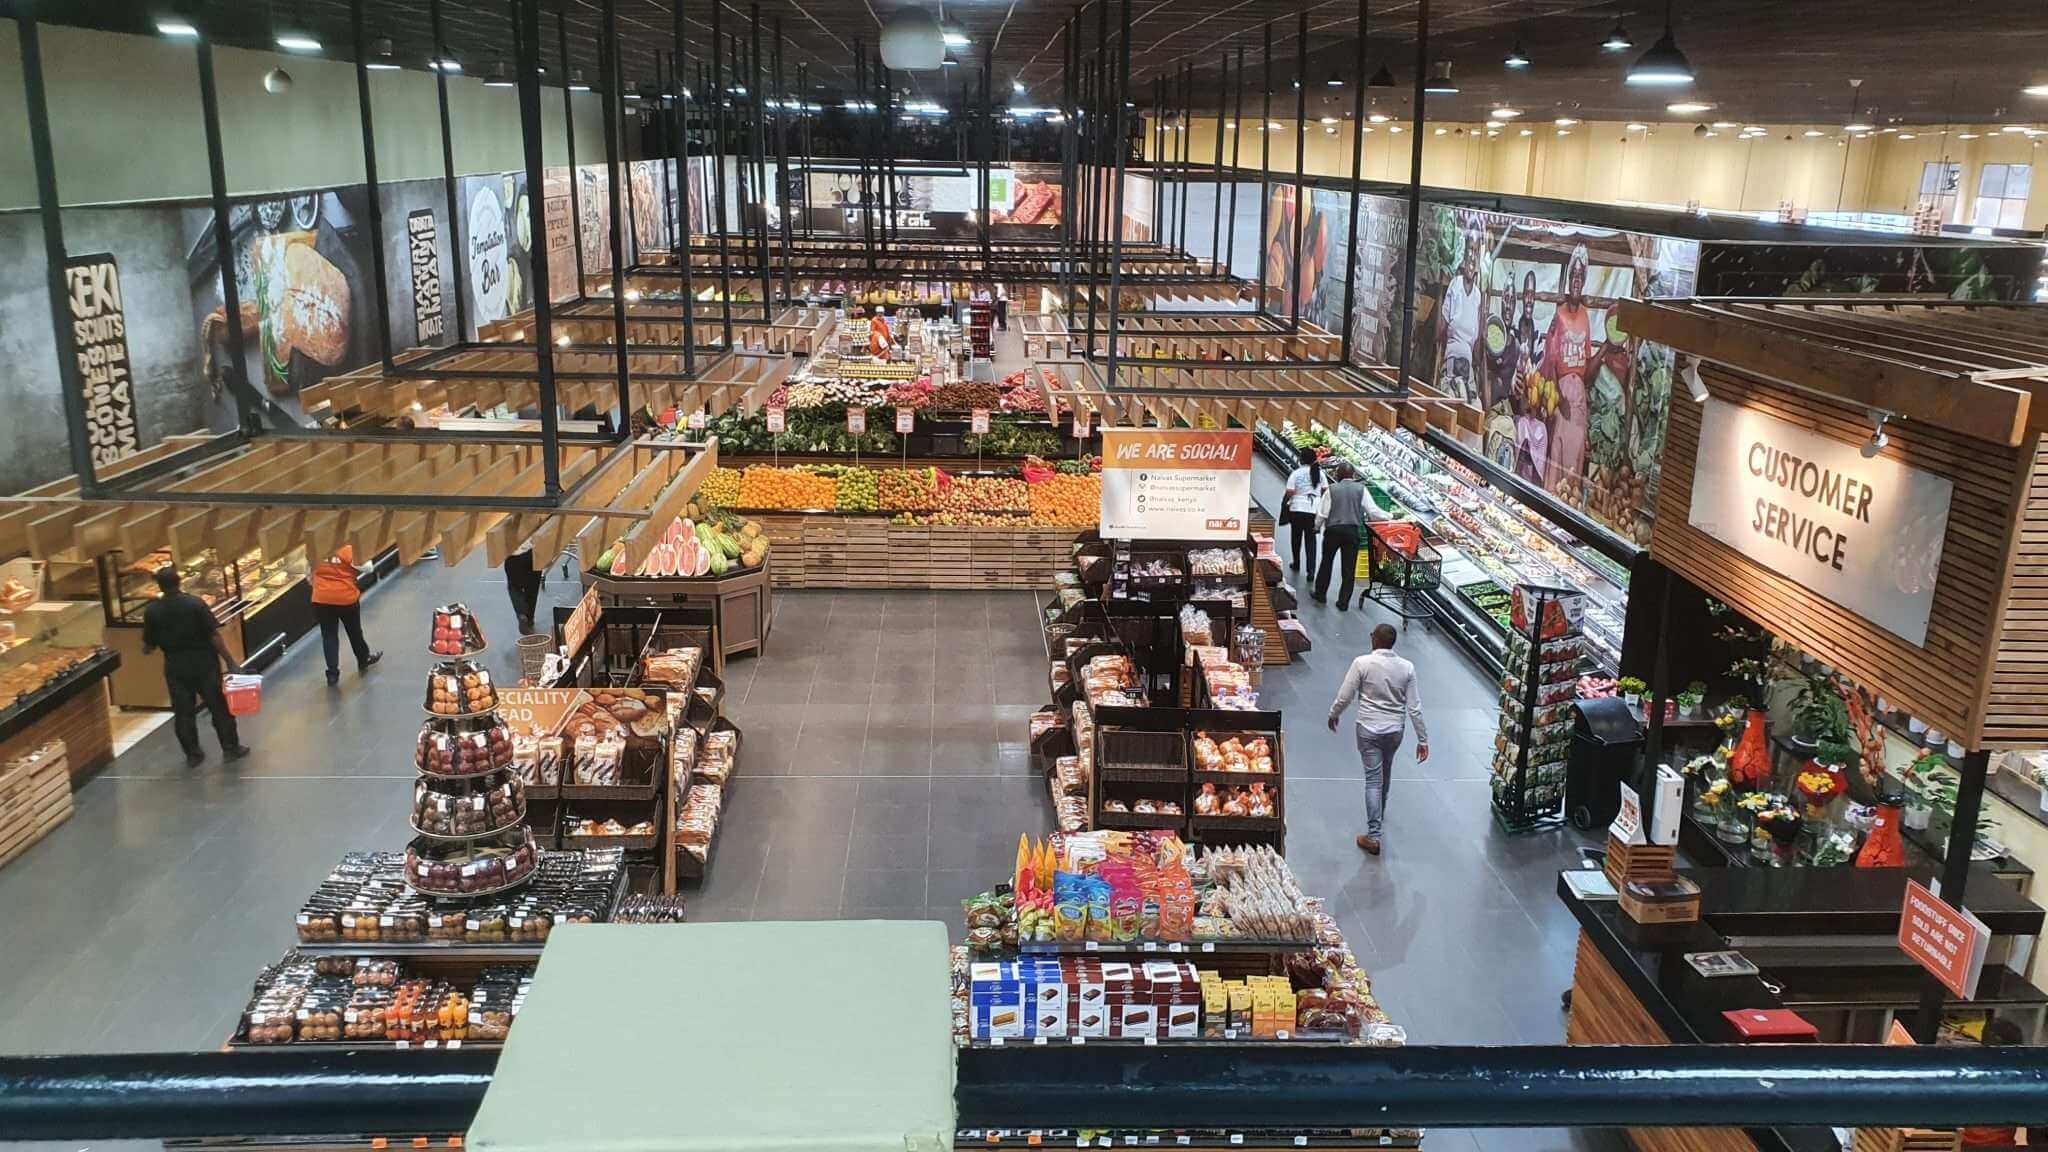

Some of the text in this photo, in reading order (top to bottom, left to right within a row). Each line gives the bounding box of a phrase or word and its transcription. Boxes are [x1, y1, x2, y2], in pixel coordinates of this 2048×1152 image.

[481, 259, 500, 294] Bar
[1116, 443, 1238, 461] WE ARE SOCIAL!
[1174, 474, 1216, 482] Supermarket
[1749, 442, 1873, 523] CUSTOMER
[1752, 497, 1847, 572] SERVICE
[498, 691, 570, 705] ECIALITY
[498, 708, 533, 721] EAD
[1910, 896, 1948, 928] FOODSTUFF
[1911, 932, 1953, 971] RETURNABLE
[1912, 915, 1958, 955] SOLD ARE NOT
